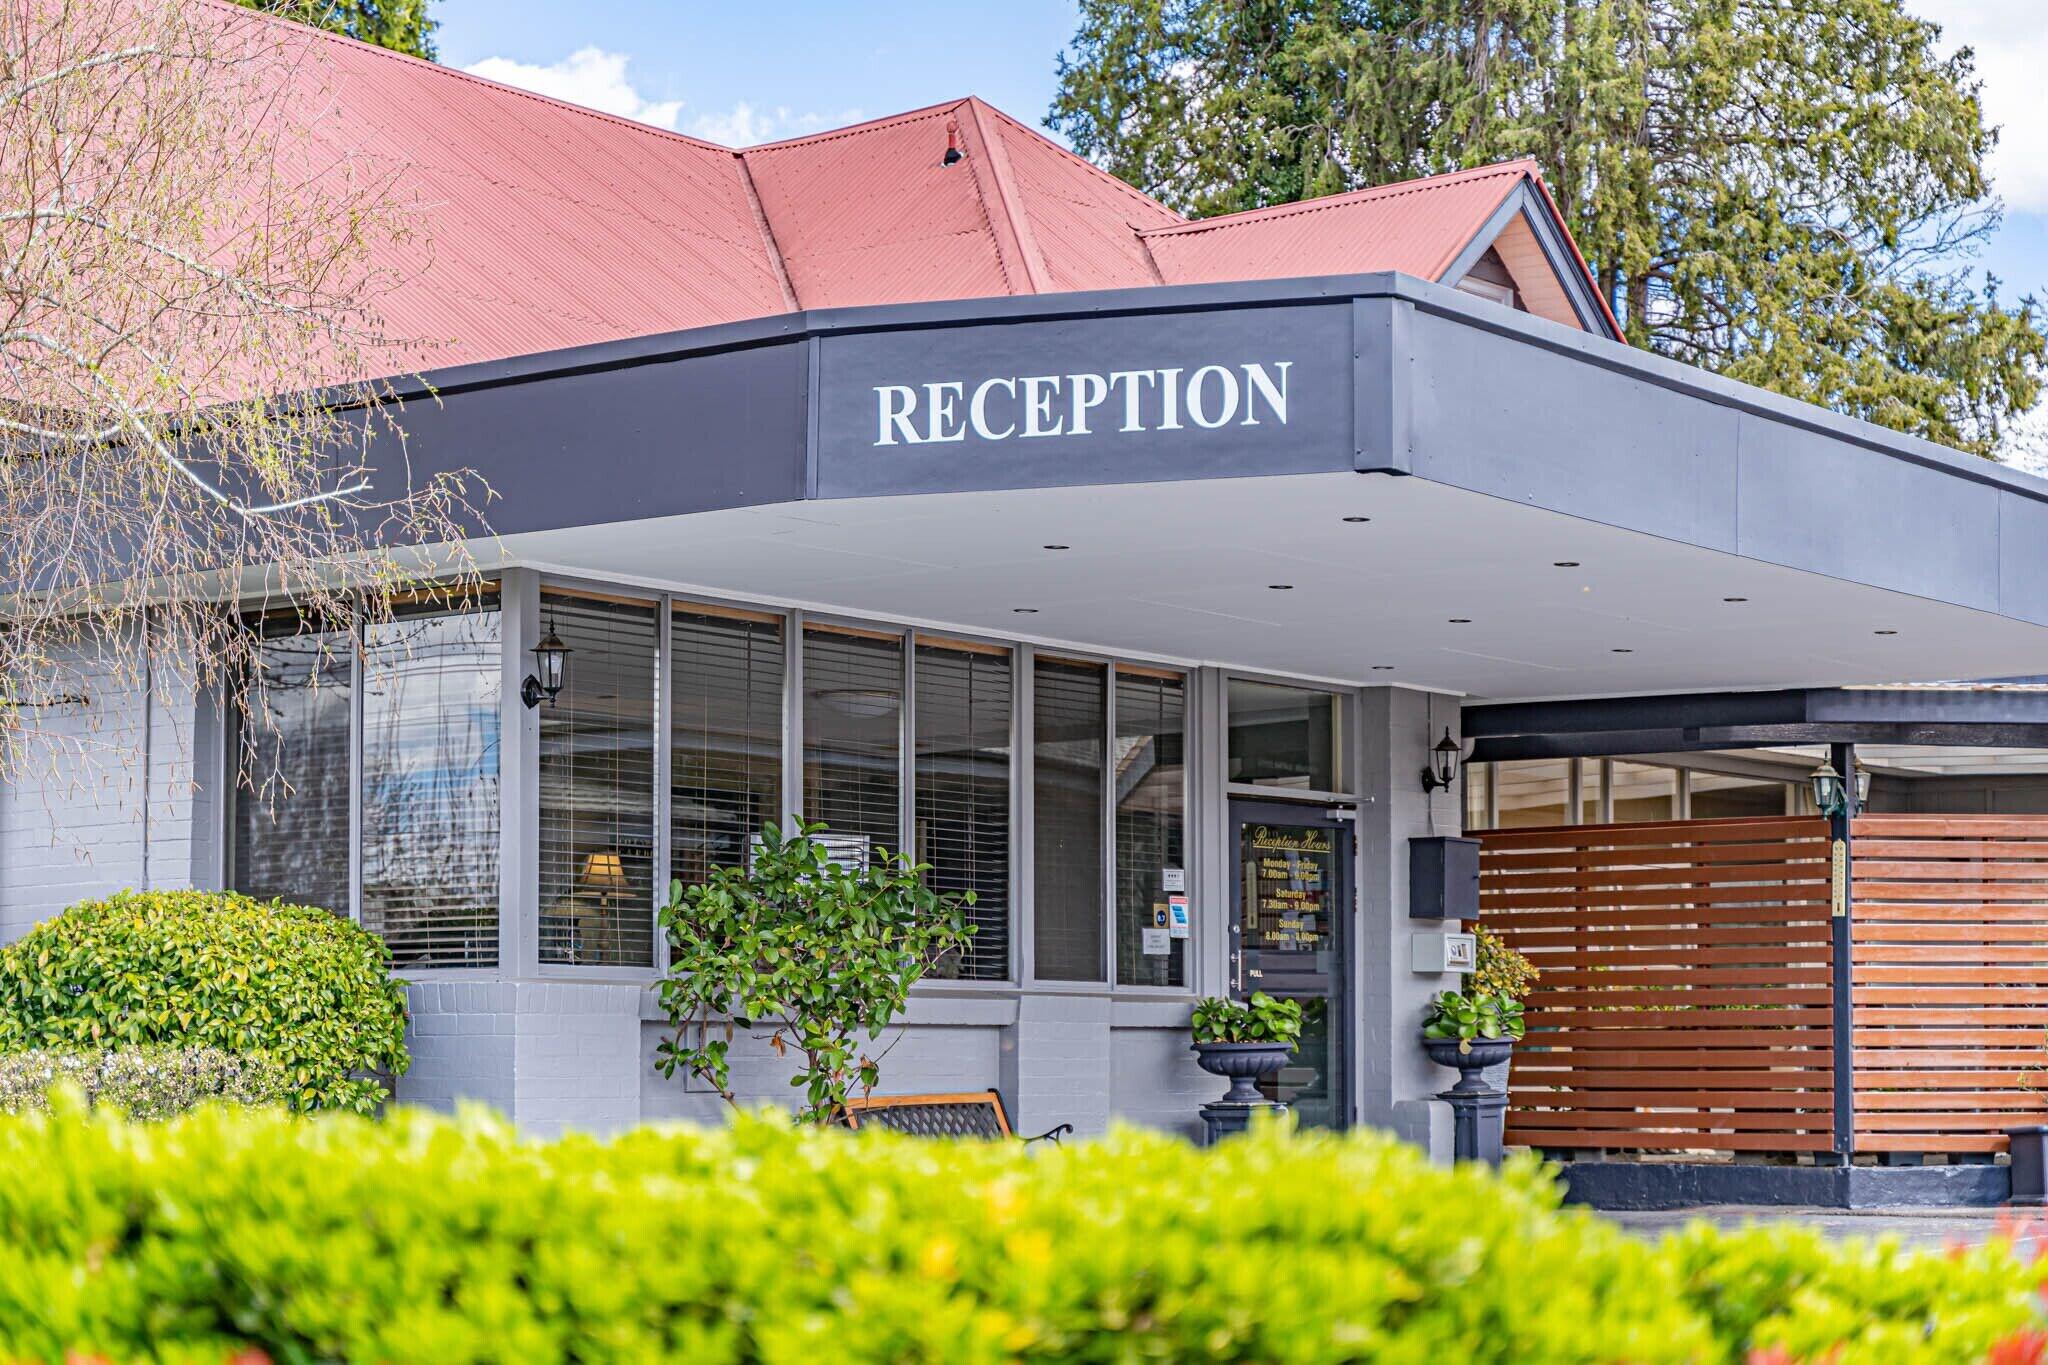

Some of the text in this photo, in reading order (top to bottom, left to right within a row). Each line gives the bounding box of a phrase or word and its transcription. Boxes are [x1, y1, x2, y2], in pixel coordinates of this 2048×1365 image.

[872, 361, 1294, 447] RECEPTION
[1253, 826, 1331, 853] Reception Hours
[1263, 858, 1290, 870] Monday
[1297, 860, 1319, 872] Friday
[1262, 868, 1288, 879] 7.00am
[1276, 888, 1306, 900] Saturday
[1262, 899, 1288, 909] 7.30am
[1279, 918, 1304, 931] Sunday
[1249, 969, 1264, 978] PULL
